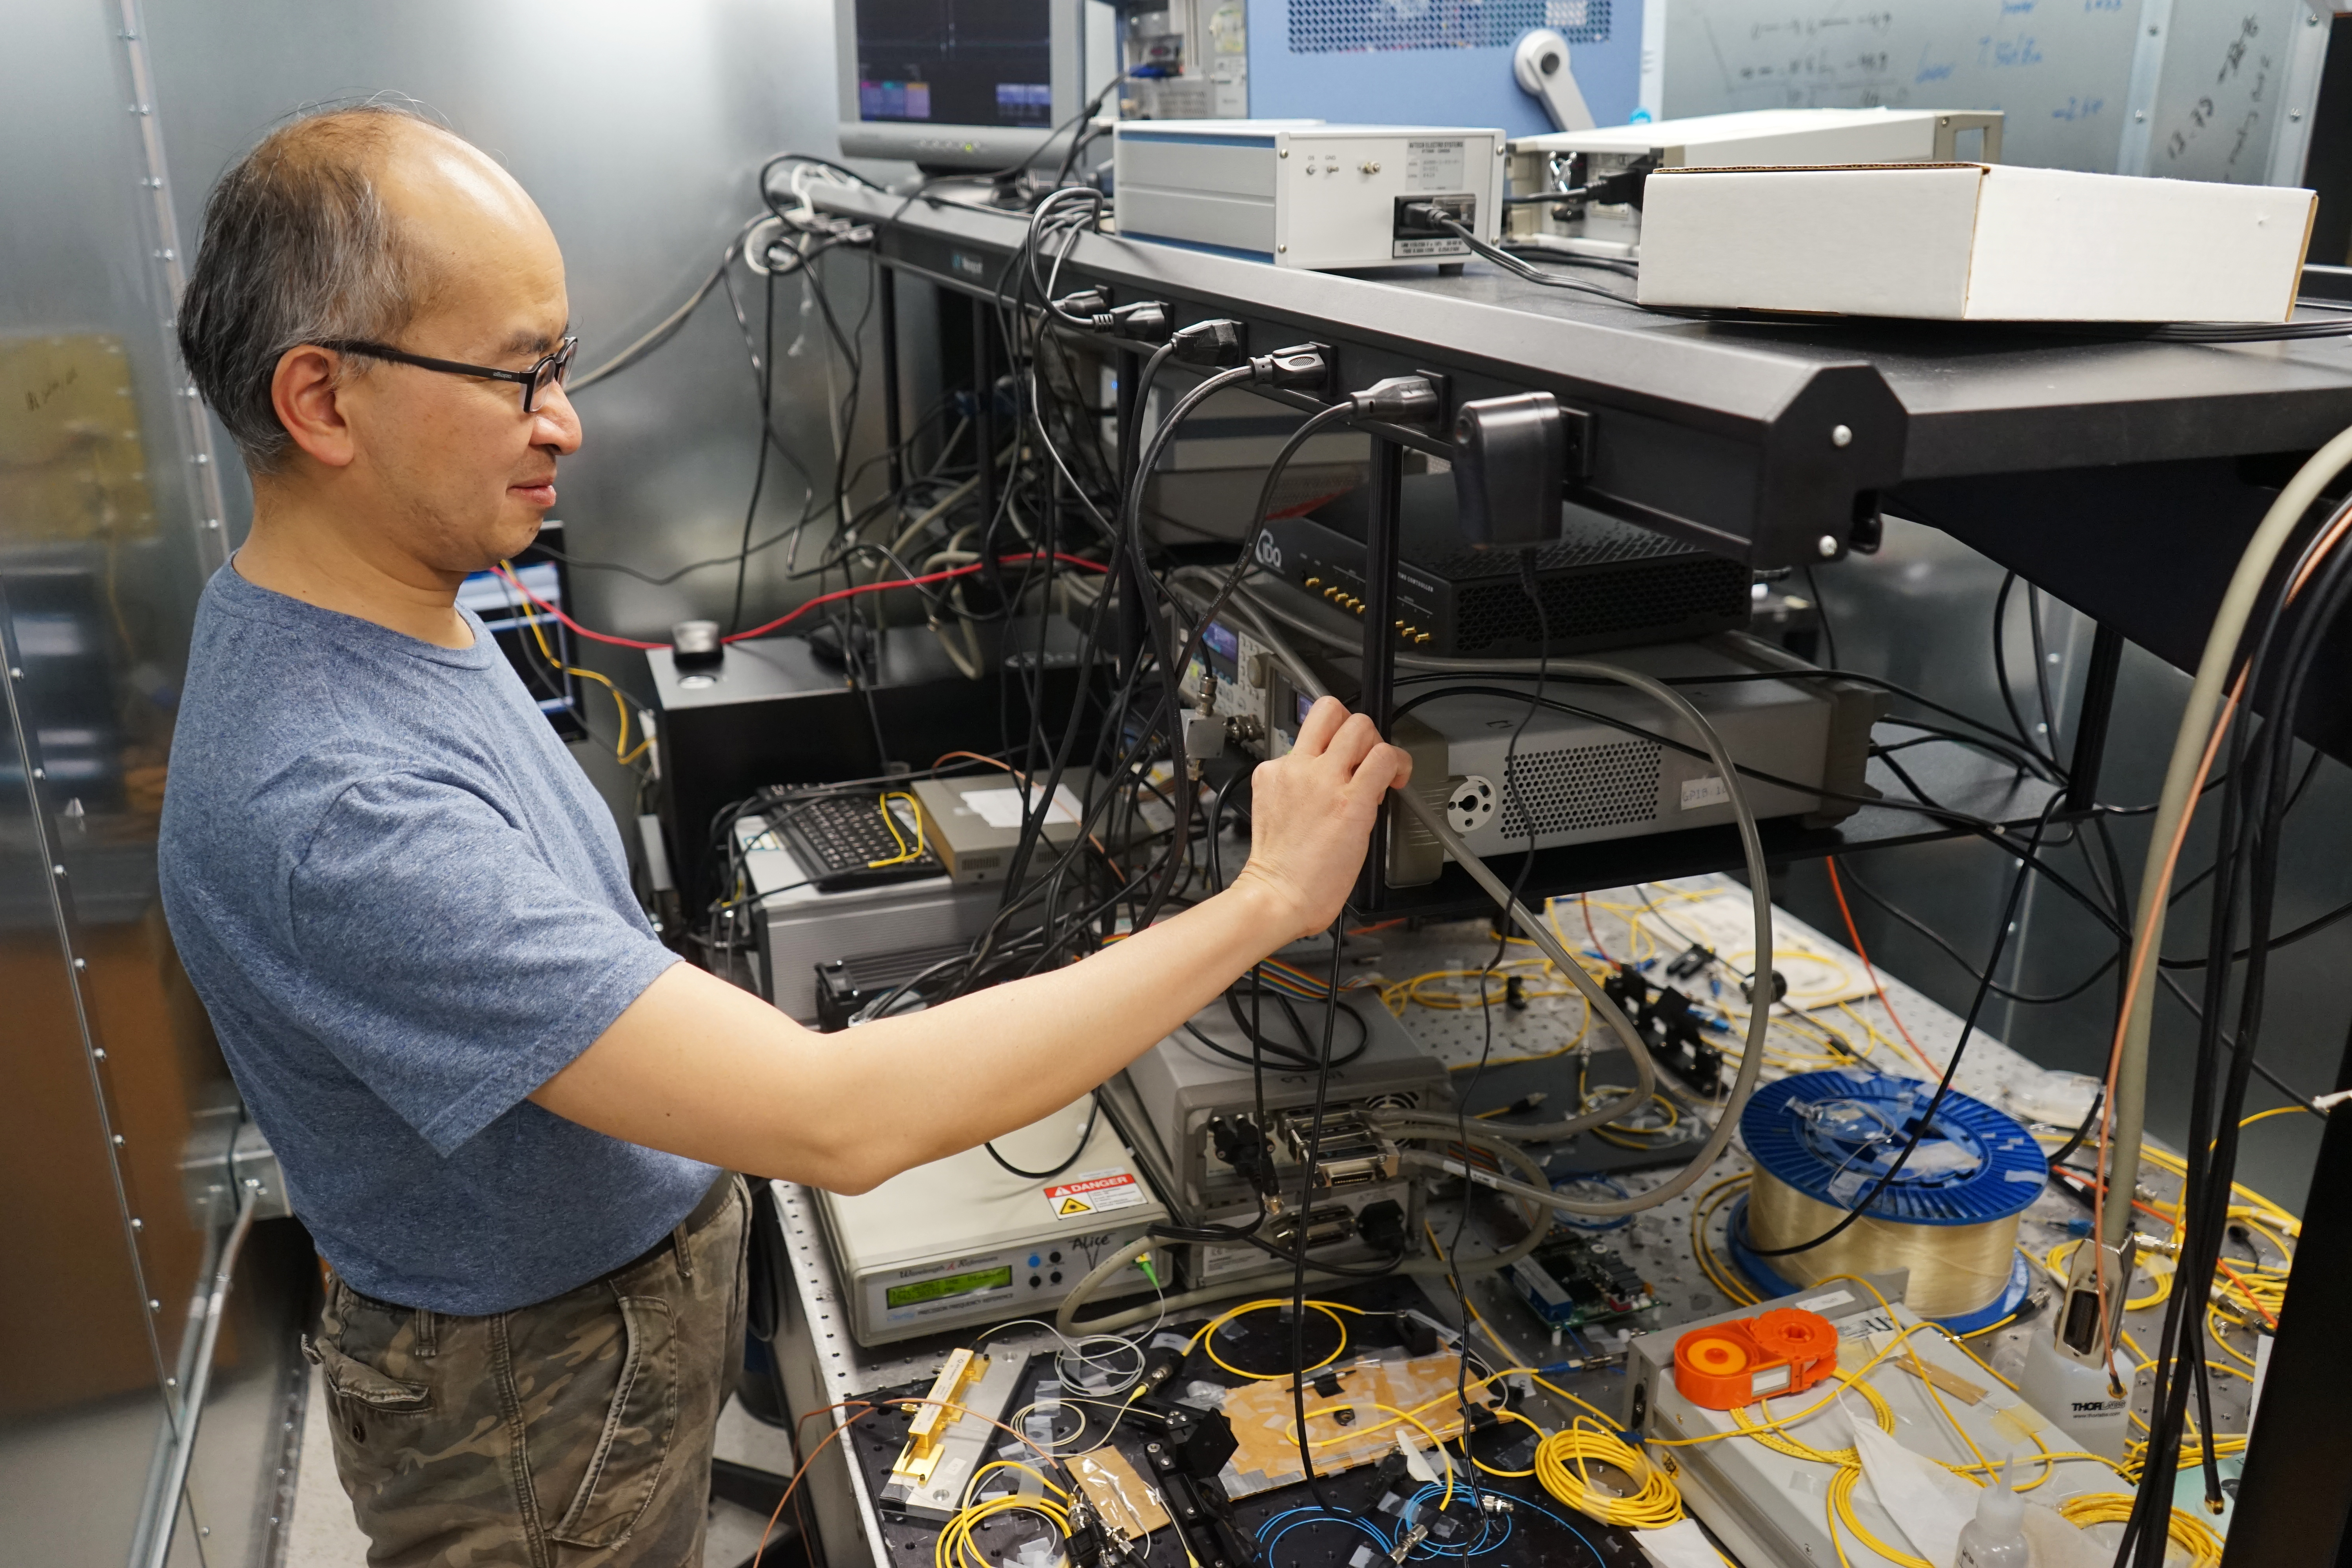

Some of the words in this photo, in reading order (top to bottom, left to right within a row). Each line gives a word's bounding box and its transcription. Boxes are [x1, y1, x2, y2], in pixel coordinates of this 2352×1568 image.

[1237, 555, 1247, 569] WIRE
[1071, 1176, 1128, 1192] DANGER
[917, 1306, 948, 1315] PRECISION
[949, 1299, 982, 1309] FREQUENCY
[982, 1294, 1013, 1303] REFERENCE
[2071, 1399, 2126, 1411] THORLABS
